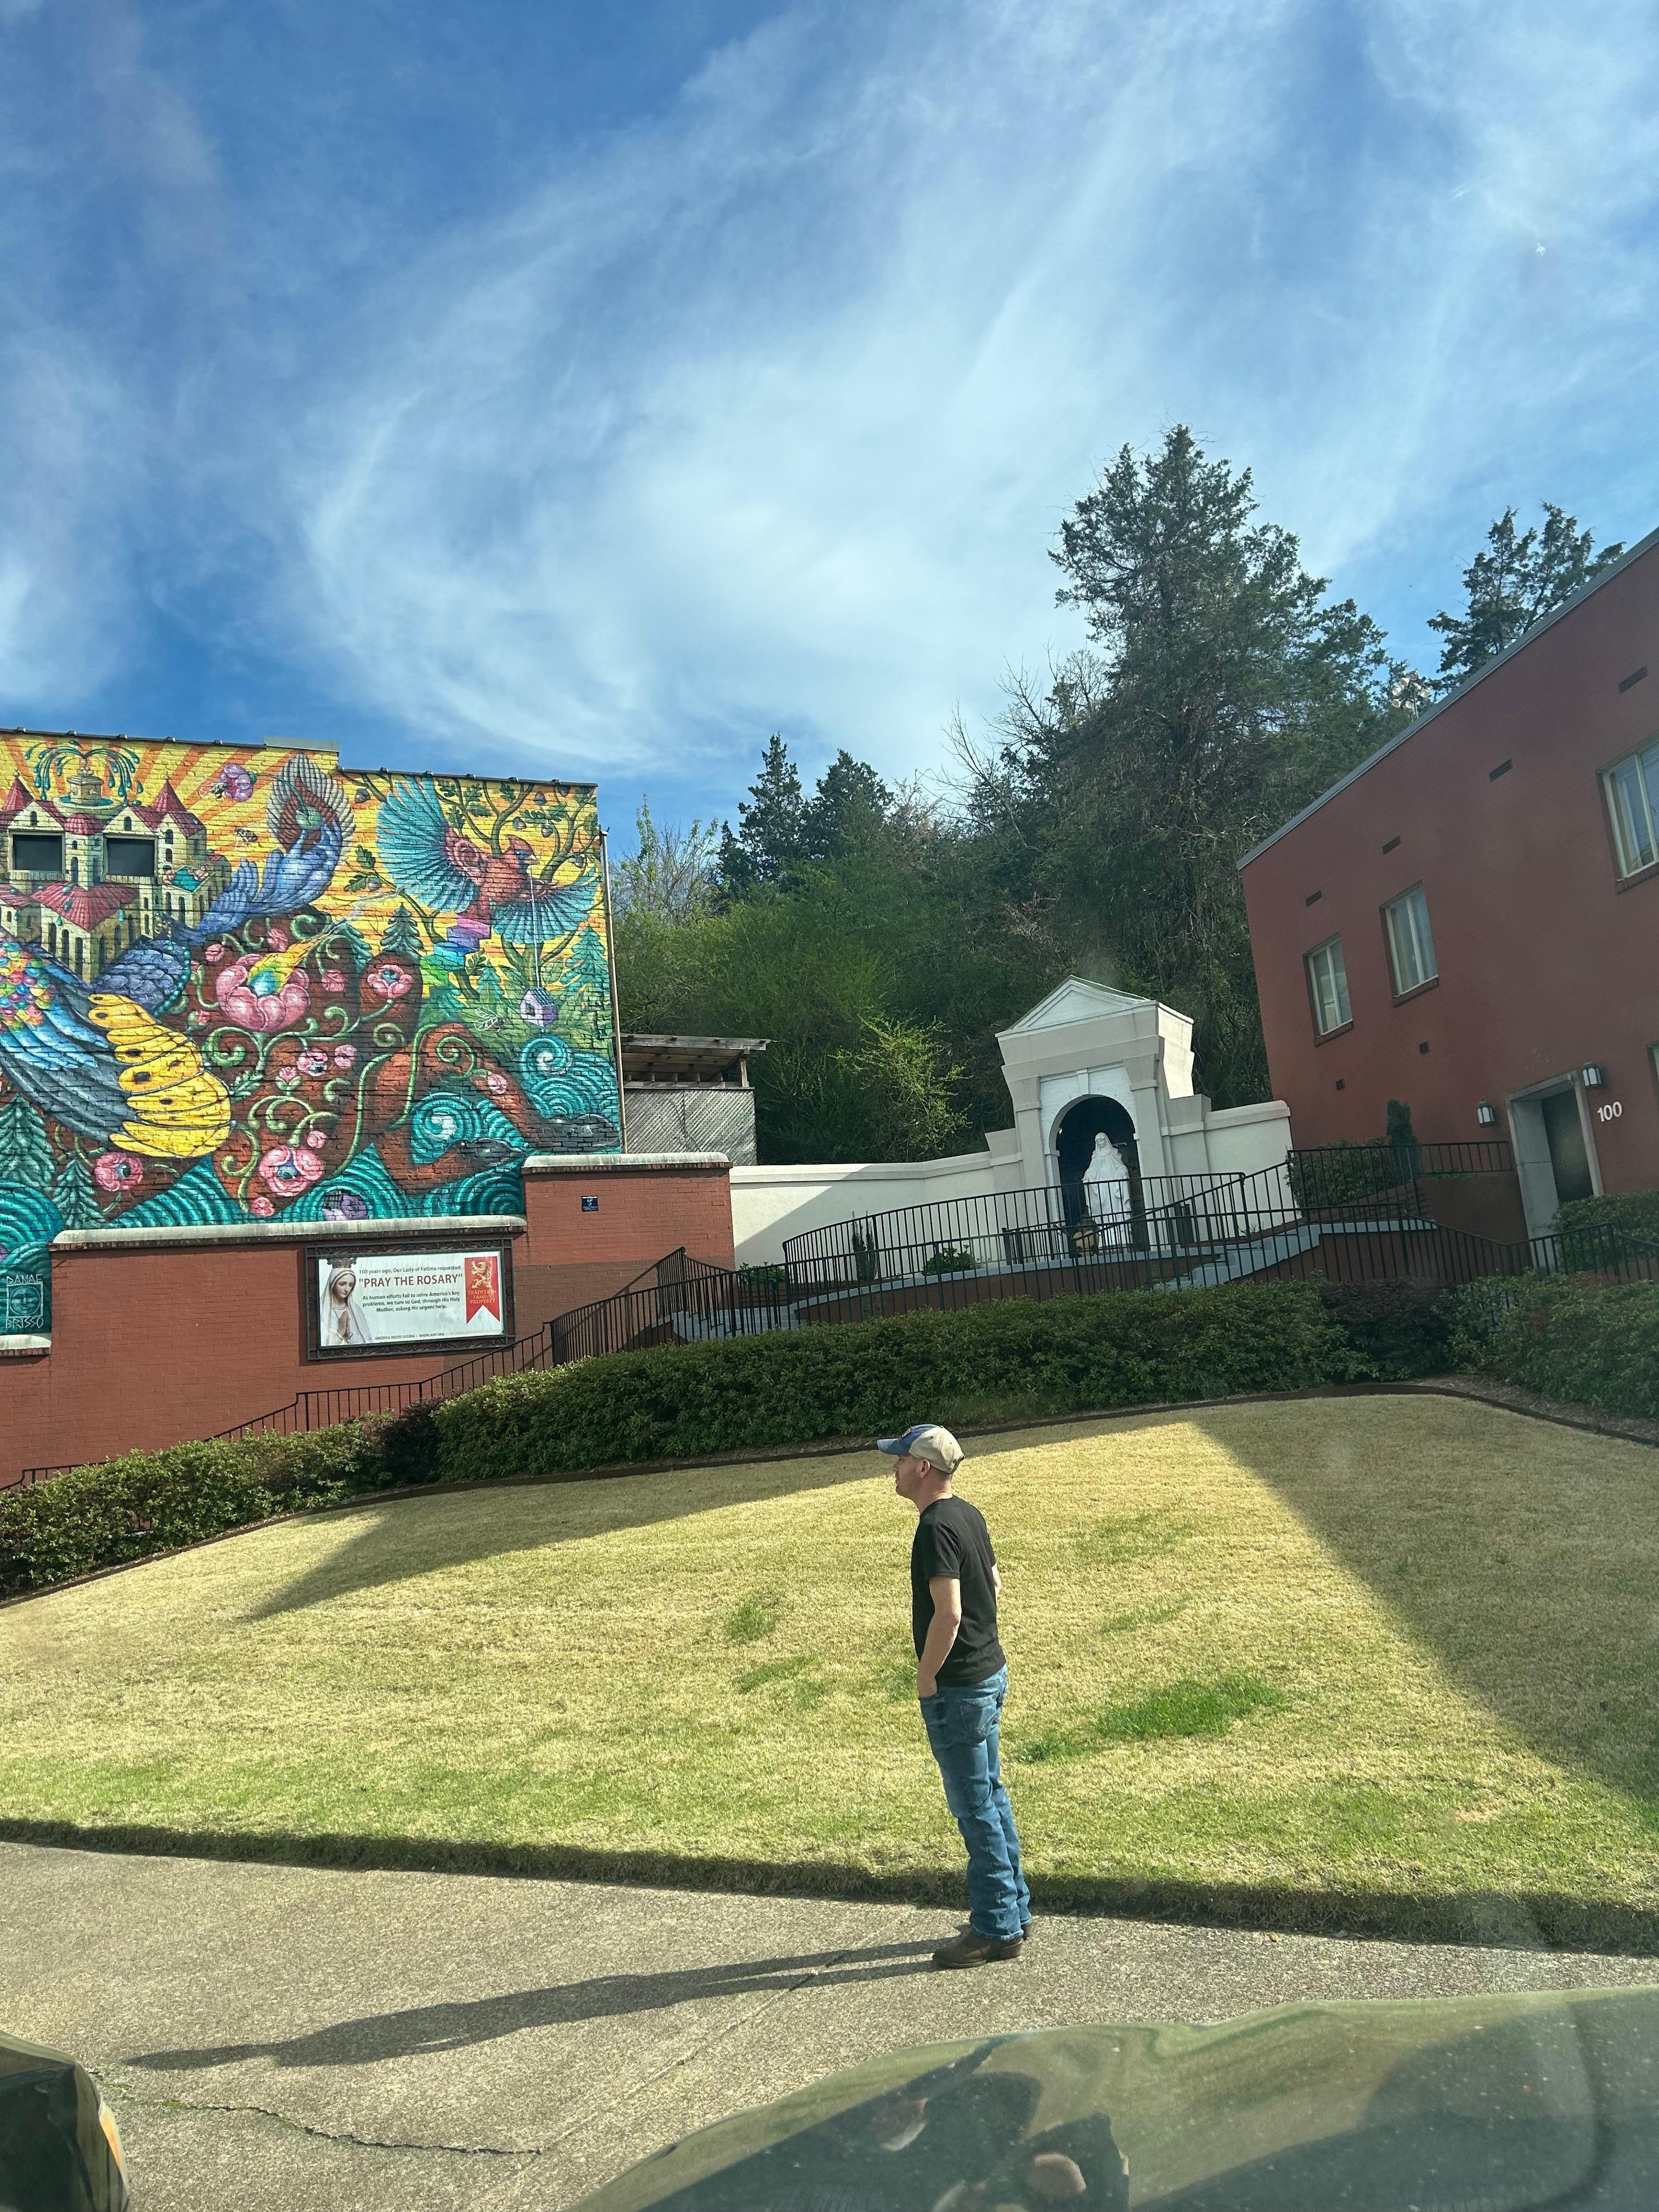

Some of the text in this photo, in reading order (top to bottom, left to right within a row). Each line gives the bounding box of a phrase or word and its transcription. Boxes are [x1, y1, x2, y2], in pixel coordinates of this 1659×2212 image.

[1597, 1101, 1622, 1122] 100
[359, 1273, 462, 1288] "PRAY THE ROSARY"
[5, 1317, 44, 1329] BRISSO
